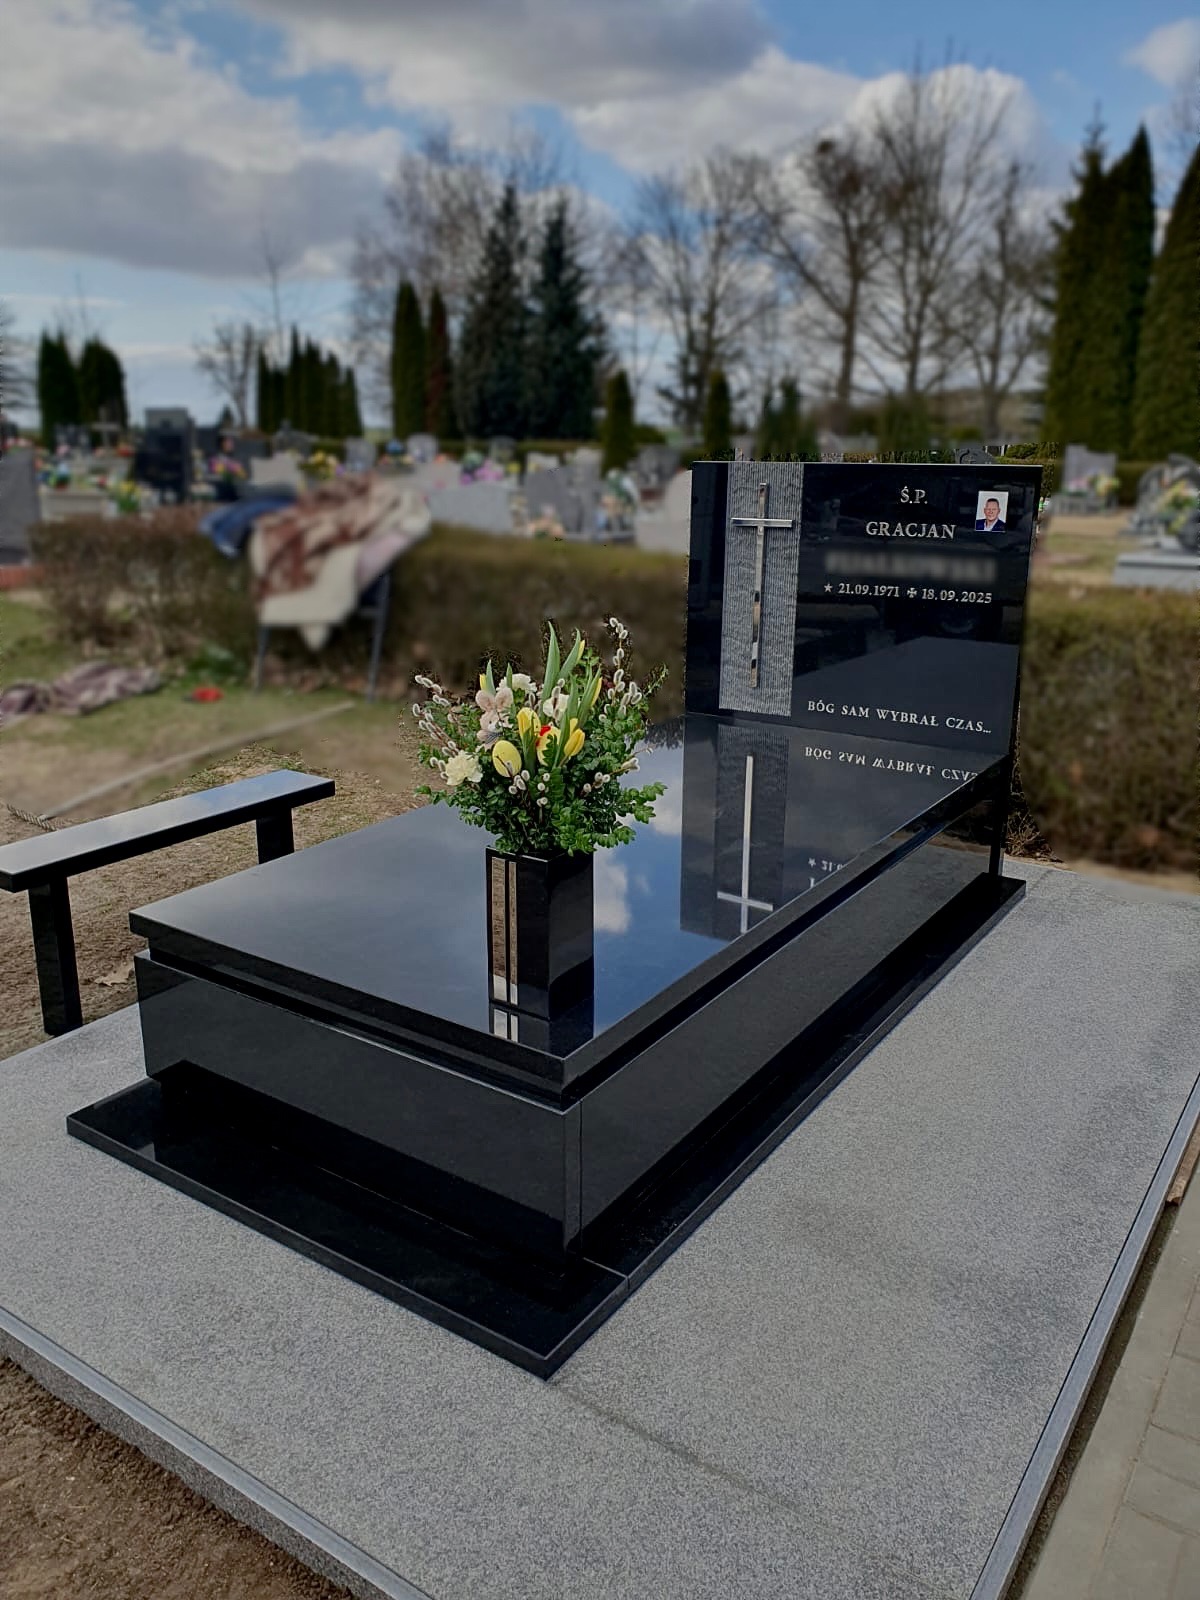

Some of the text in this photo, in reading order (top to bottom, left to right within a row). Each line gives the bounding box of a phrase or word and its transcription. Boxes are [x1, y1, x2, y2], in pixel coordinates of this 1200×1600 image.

[900, 486, 928, 504] Ś.P.
[866, 521, 957, 539] GRACJAN
[838, 583, 993, 604] 21.09.1971 18.09.2025
[807, 700, 992, 734] BÓG SAM WYBRAŁ CZAS...
